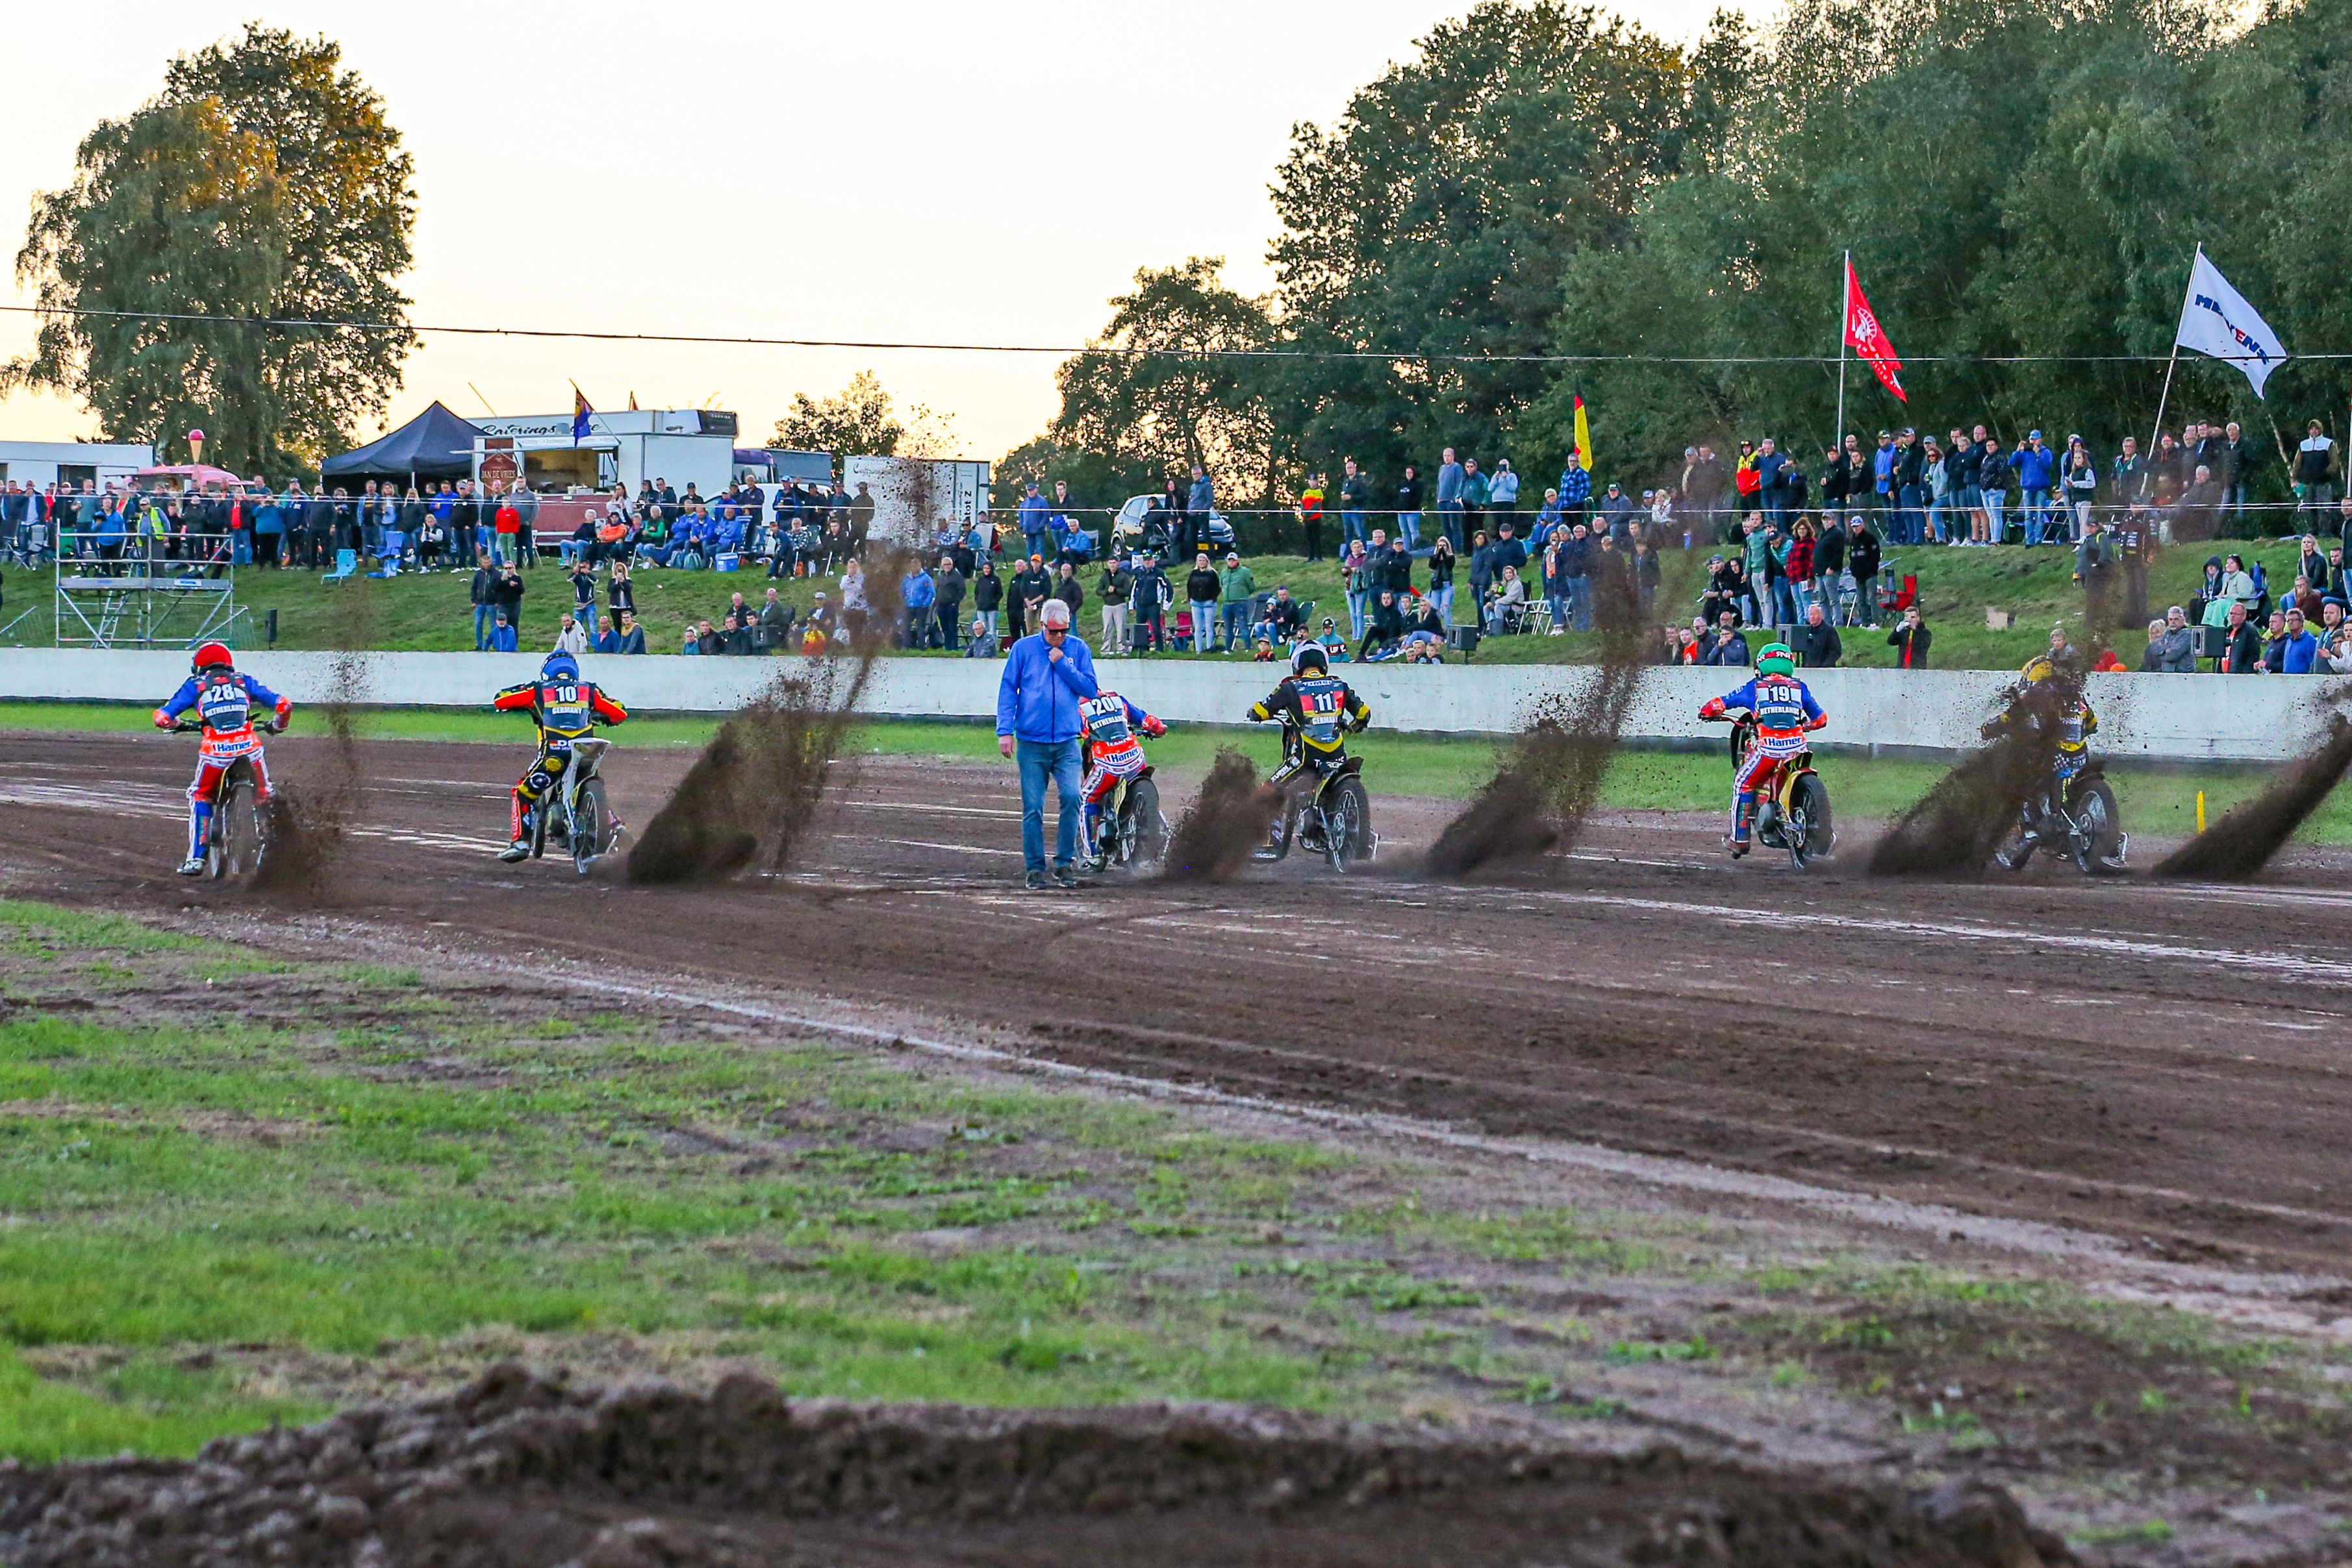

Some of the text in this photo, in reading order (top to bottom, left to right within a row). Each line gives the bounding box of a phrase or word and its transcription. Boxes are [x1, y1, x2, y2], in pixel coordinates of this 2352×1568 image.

[492, 470, 500, 479] DE
[500, 470, 516, 479] VRIES
[211, 683, 234, 703] 28
[556, 687, 577, 702] 10
[1770, 686, 1789, 702] 19
[1091, 697, 1115, 715] 20
[1315, 693, 1332, 711] 11
[1760, 706, 1799, 716] NETHERLANDS
[1312, 716, 1338, 725] GERMANY
[218, 740, 251, 752] Hamer
[1769, 737, 1801, 746] Hamer
[1111, 748, 1139, 763] Hamer
